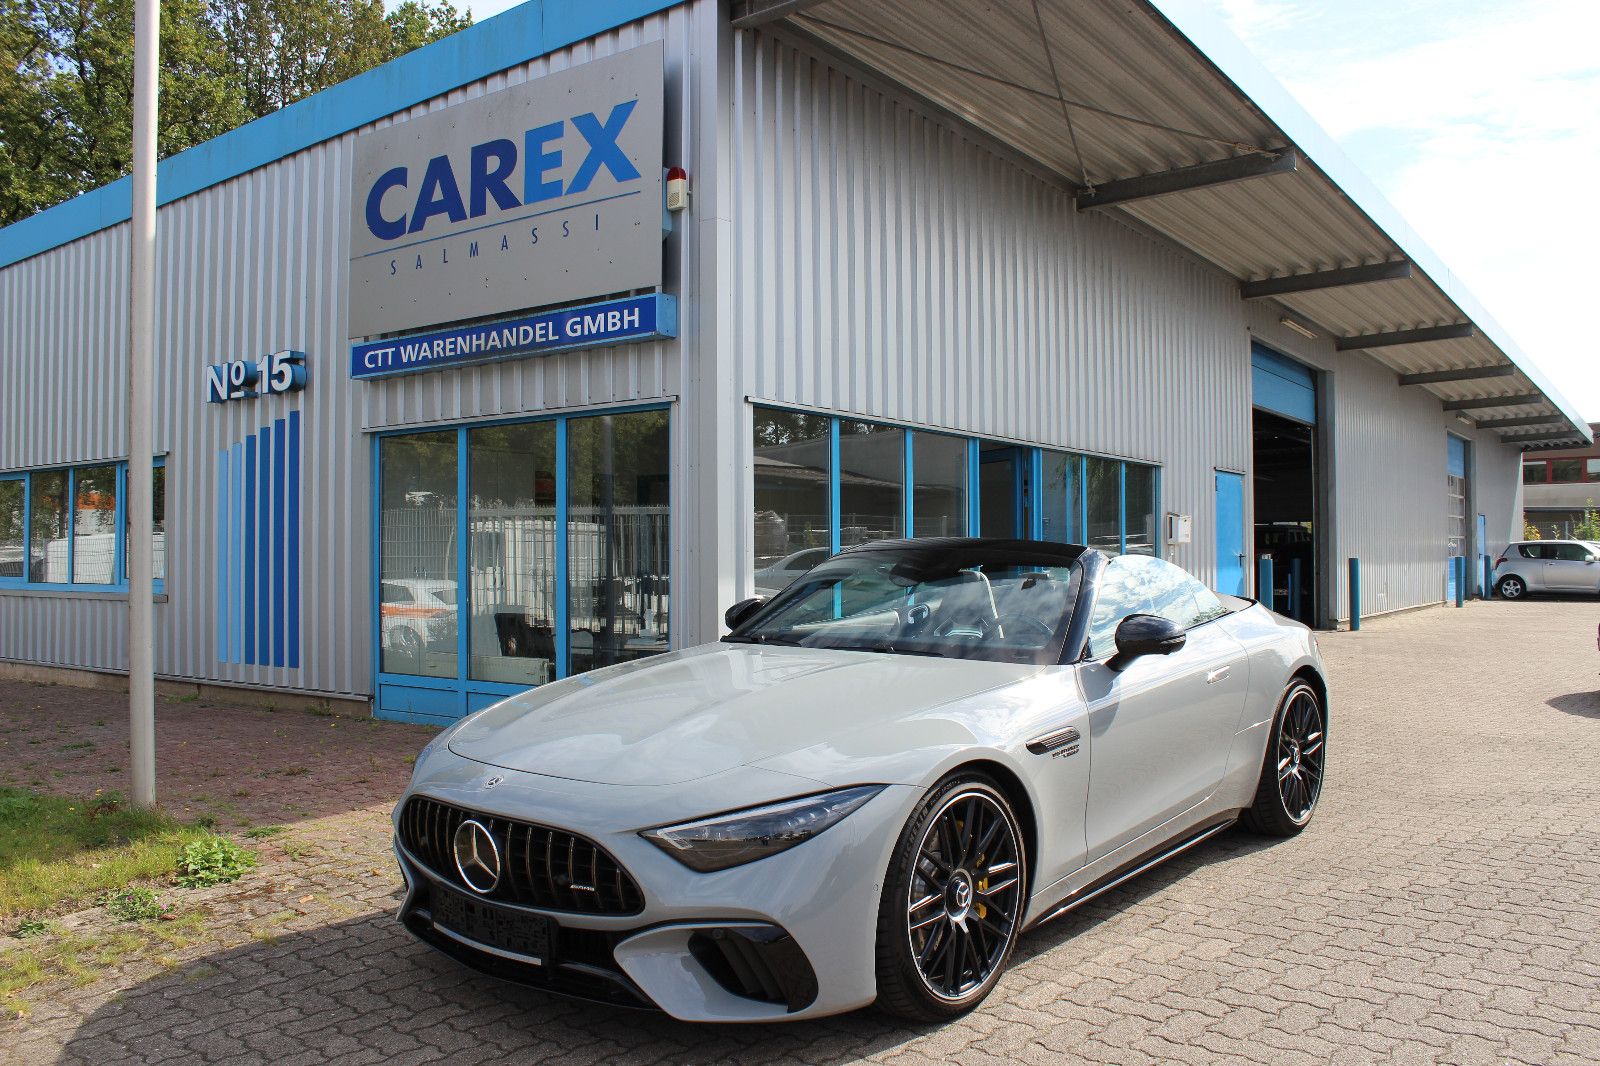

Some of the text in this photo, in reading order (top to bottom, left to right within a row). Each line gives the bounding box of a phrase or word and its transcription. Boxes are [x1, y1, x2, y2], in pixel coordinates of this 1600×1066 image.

[365, 99, 642, 241] CAREX
[390, 213, 600, 276] SALMASSI
[364, 306, 640, 369] CTT WARENHANDEL GMBH
[257, 350, 294, 394] 15
